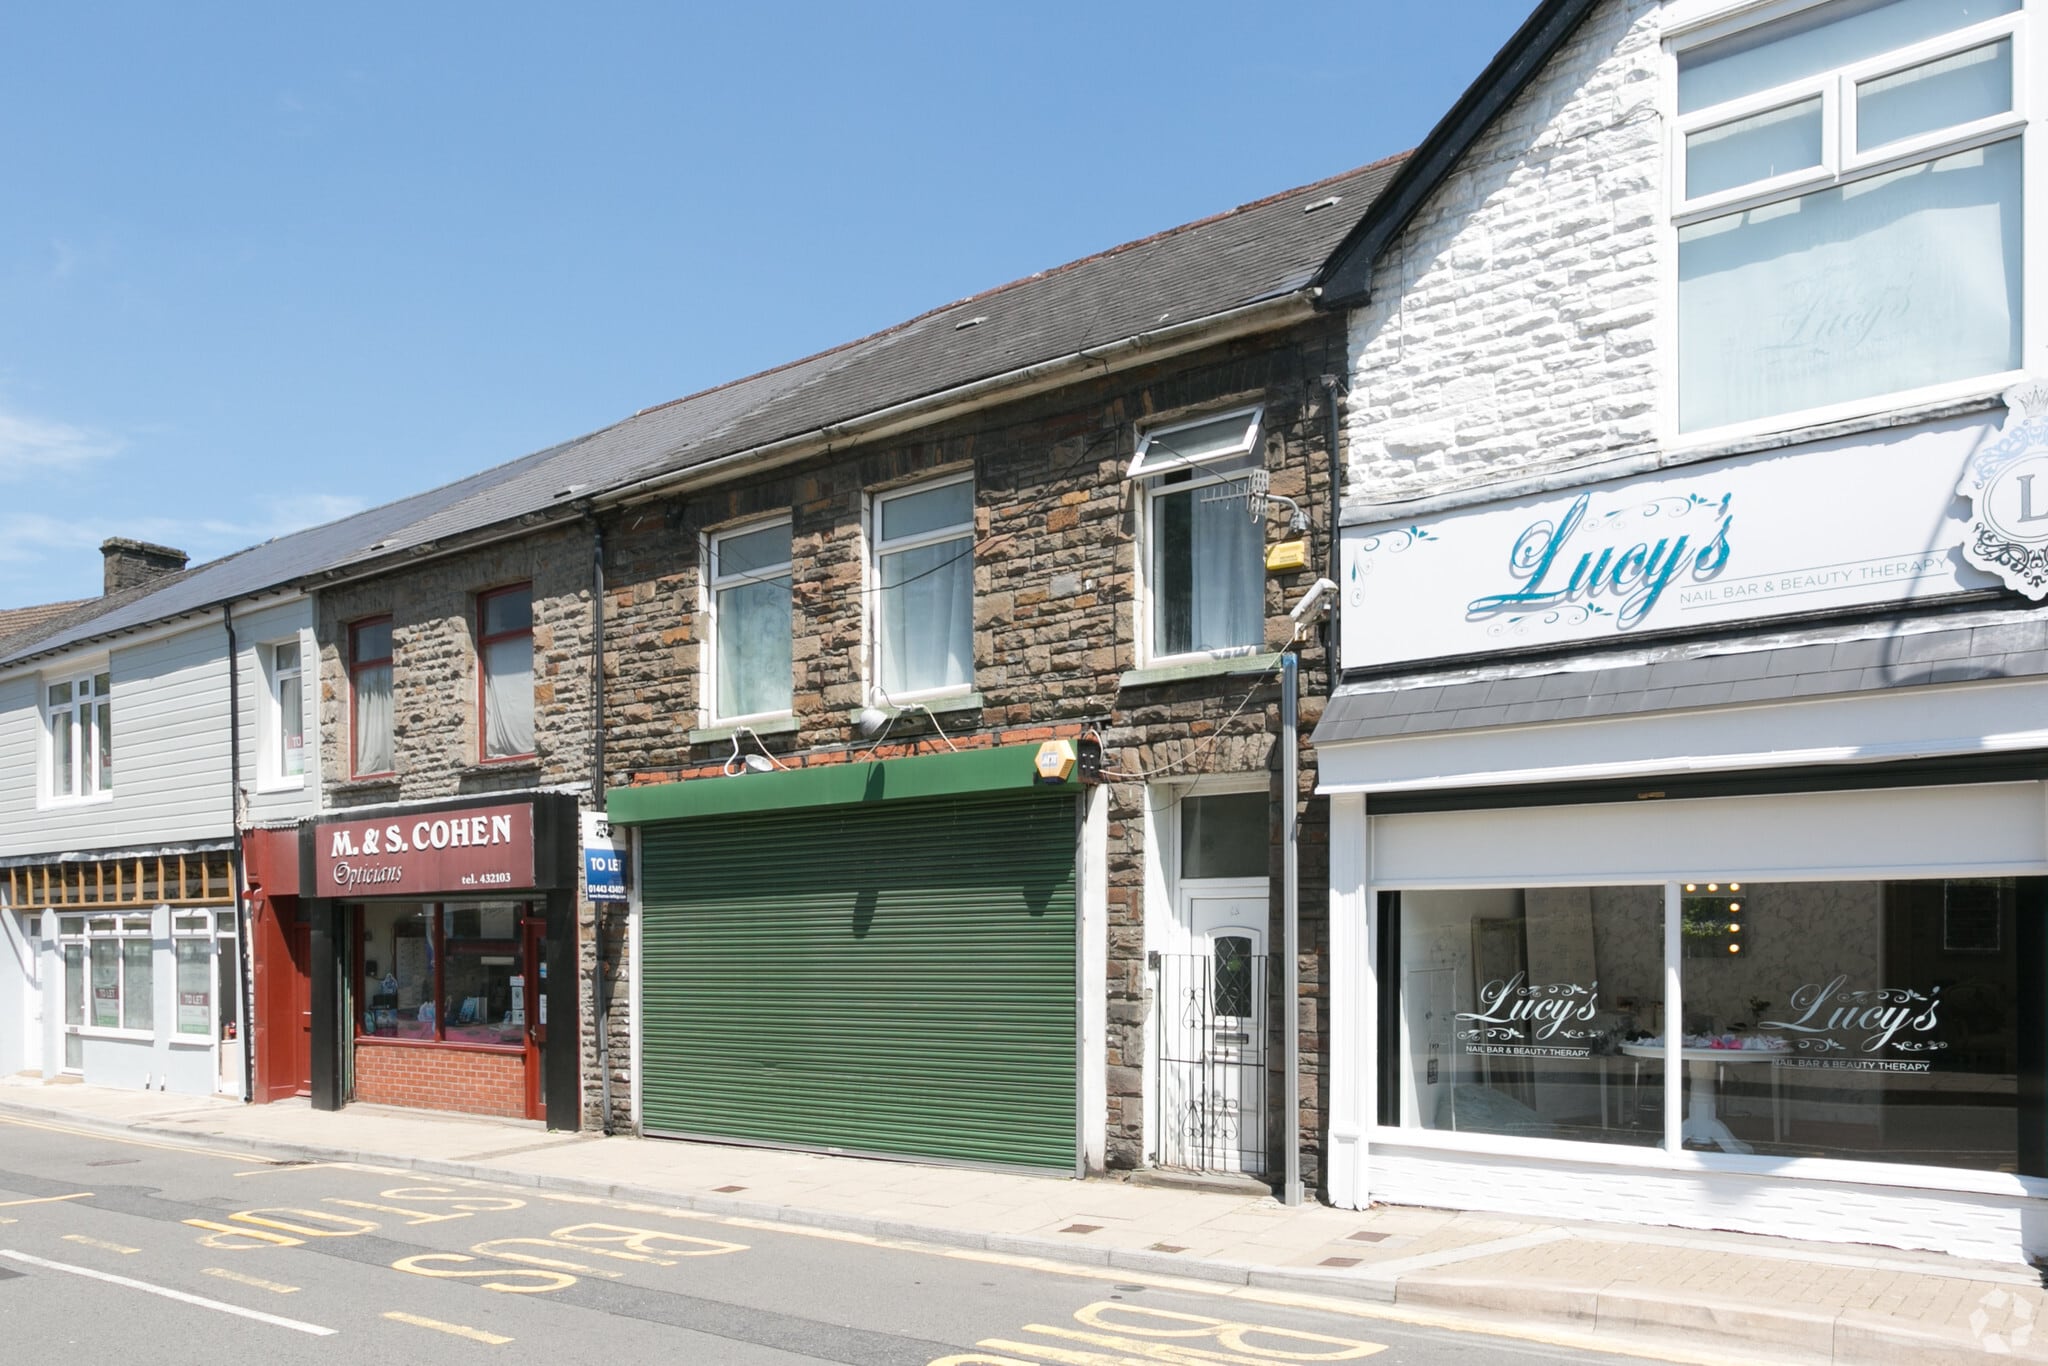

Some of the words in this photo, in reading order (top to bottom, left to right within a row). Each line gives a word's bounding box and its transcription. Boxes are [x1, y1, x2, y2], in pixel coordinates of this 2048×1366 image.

[1467, 491, 1733, 621] Lucy's
[1680, 591, 1717, 605] NAIL
[1723, 584, 1758, 599] BAR
[1763, 581, 1774, 593] &
[1781, 569, 1853, 590] BEAUTY
[1859, 557, 1948, 580] THERAPY
[331, 830, 359, 857] M.
[362, 828, 380, 855] &
[385, 825, 409, 853] S.
[412, 814, 512, 851] COHEN
[333, 861, 402, 892] Opticians
[461, 875, 478, 885] tel.
[479, 872, 512, 885] 432103
[590, 857, 606, 871] TO
[608, 859, 622, 872] LET
[184, 994, 192, 1004] TO
[193, 994, 204, 1004] LET
[1455, 970, 1598, 1040] Lucy's
[1759, 974, 1941, 1053] Lucy's
[1465, 1045, 1485, 1053] NAIL
[1487, 1046, 1504, 1054] BAR
[1506, 1046, 1512, 1054] &
[1513, 1047, 1547, 1056] BEAUTY
[1550, 1049, 1590, 1057] THERAPY
[1772, 1058, 1795, 1066] NAIL
[1799, 1059, 1820, 1067] BAR
[1822, 1060, 1830, 1068] &
[1832, 1060, 1875, 1070] BEAUTY
[1879, 1061, 1930, 1071] THERAPY
[182, 1187, 527, 1249] STOP
[391, 1222, 752, 1293] BUS
